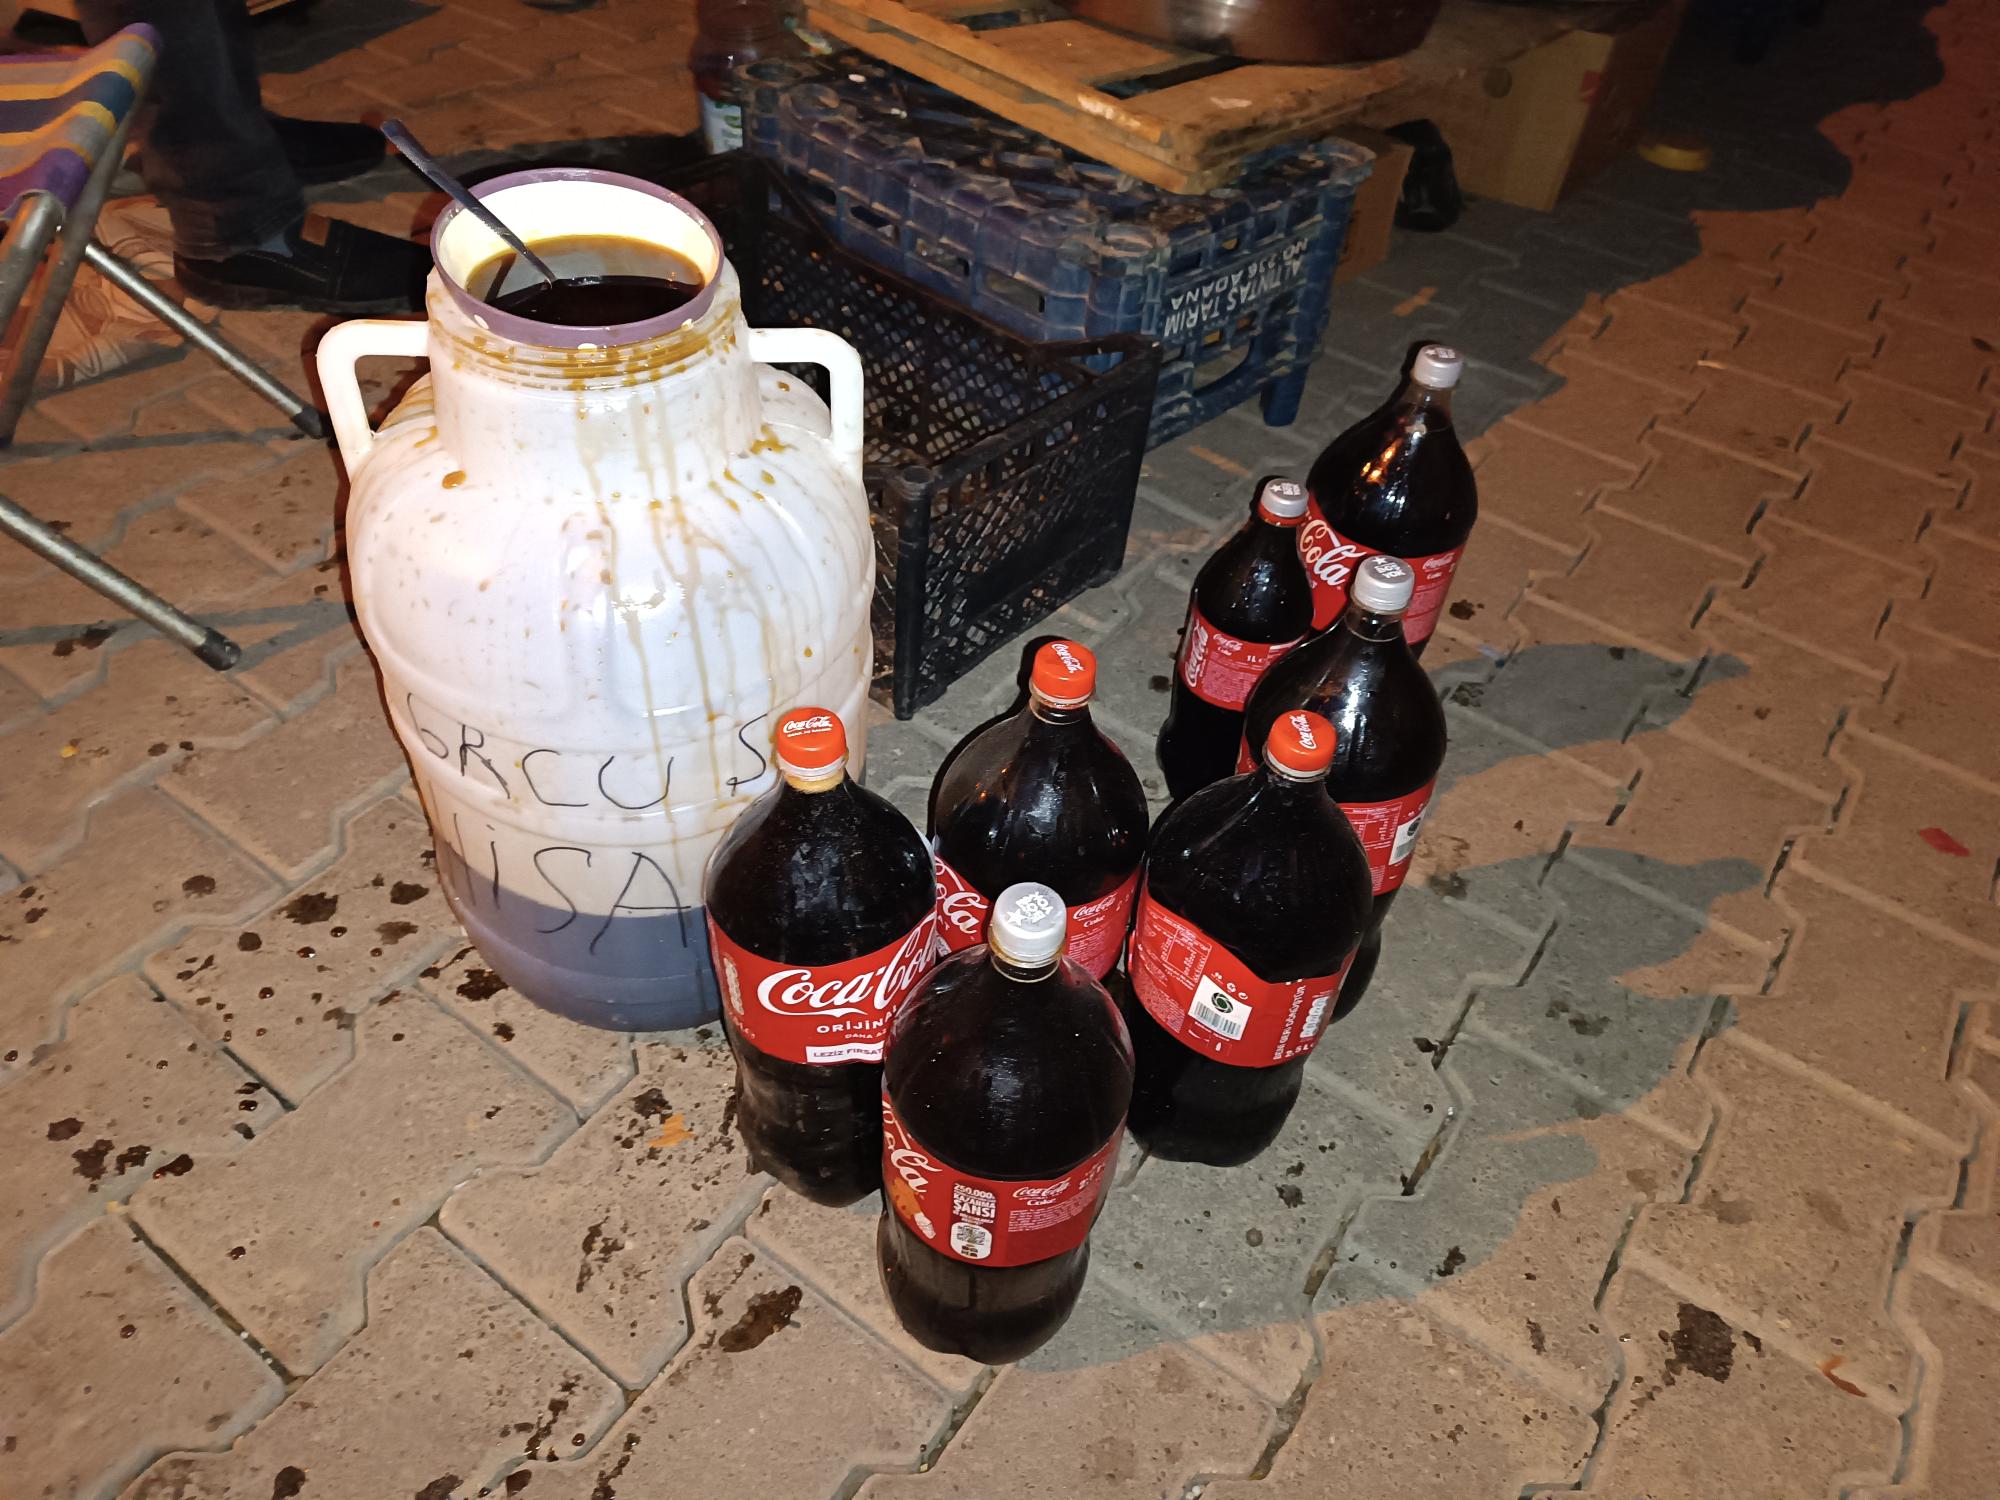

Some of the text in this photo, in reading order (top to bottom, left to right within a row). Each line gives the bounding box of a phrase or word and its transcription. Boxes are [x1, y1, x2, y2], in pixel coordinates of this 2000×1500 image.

[1163, 294, 1221, 337] TARIM
[1051, 643, 1086, 674] Coca-Cola
[782, 715, 834, 734] Coca-Cola
[1289, 714, 1317, 750] Coca-Cola
[1073, 891, 1119, 920] Coca-Cola
[1012, 1177, 1072, 1198] Coca-Cola
